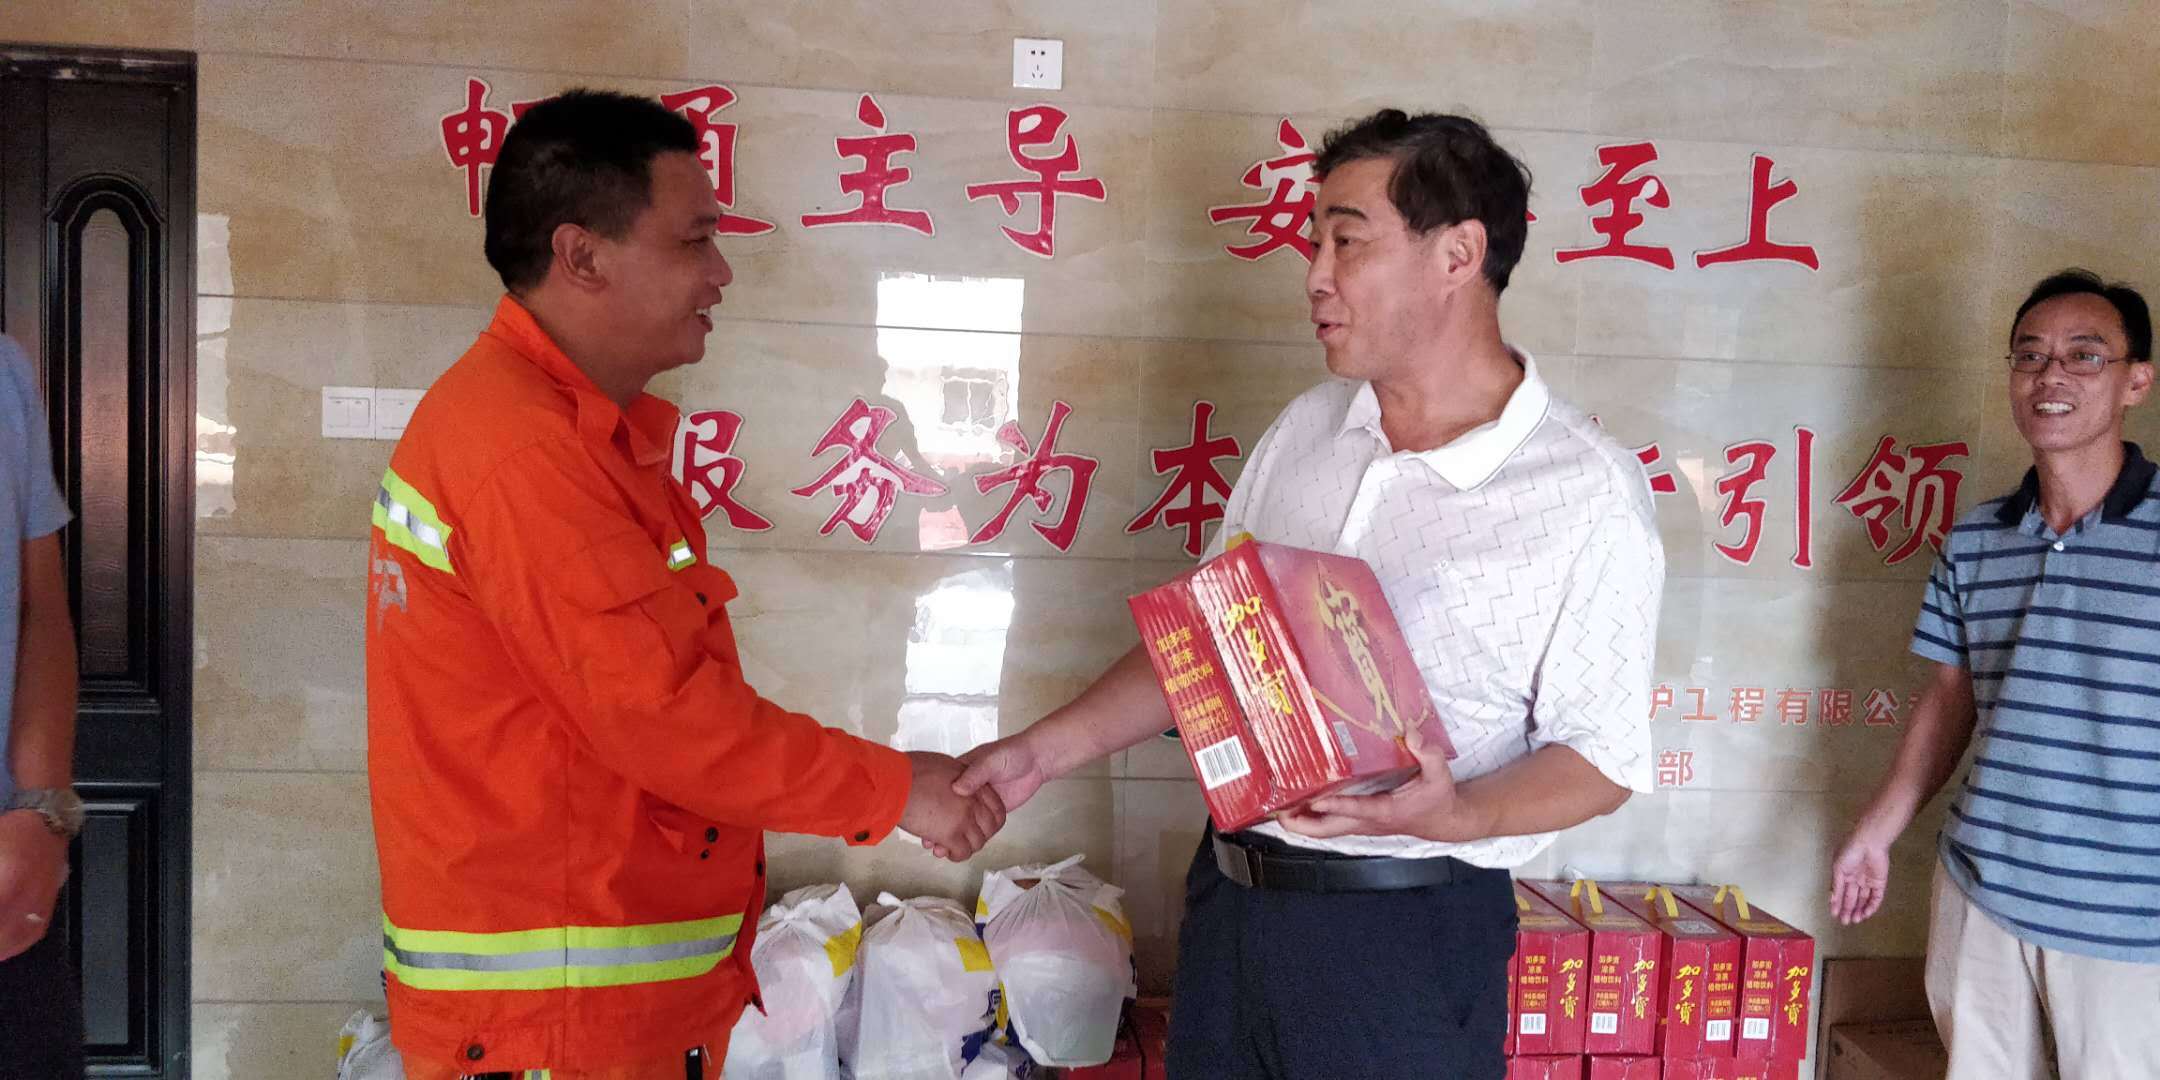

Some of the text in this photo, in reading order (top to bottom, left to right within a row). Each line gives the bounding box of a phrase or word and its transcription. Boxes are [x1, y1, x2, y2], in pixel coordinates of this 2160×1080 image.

[1208, 117, 1820, 272] 安至上
[672, 399, 1242, 558] 服务为本
[1164, 663, 1215, 695] 植物饮料
[1657, 750, 1695, 787] 部
